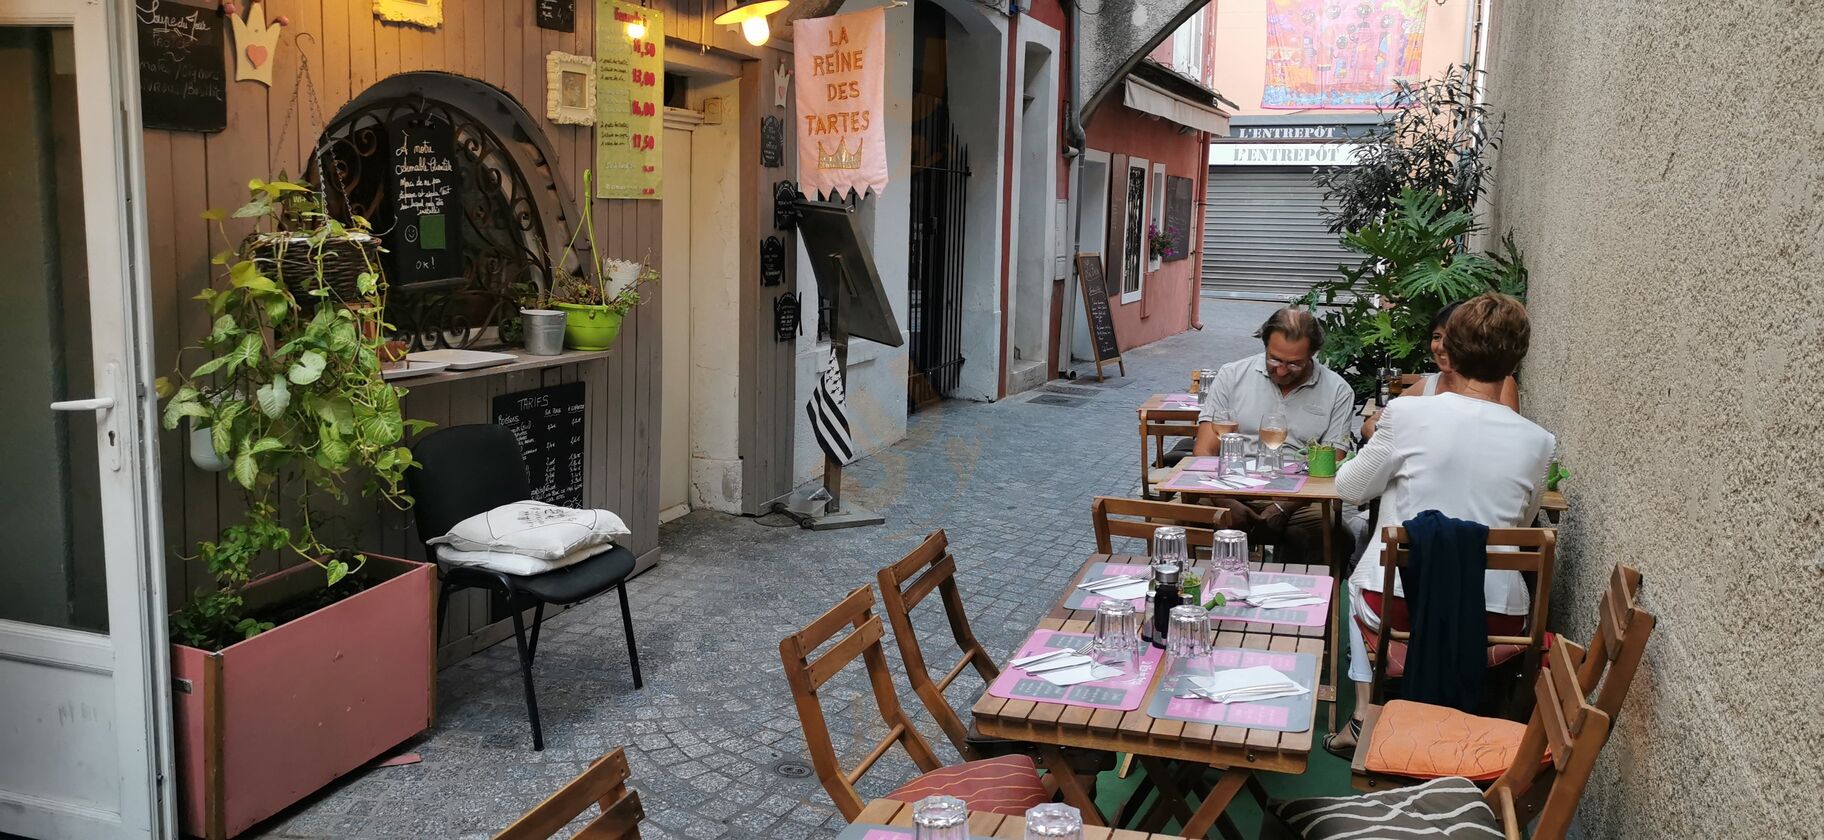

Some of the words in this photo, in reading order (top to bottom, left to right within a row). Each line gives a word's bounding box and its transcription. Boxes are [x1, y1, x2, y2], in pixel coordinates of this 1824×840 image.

[829, 27, 849, 47] LA
[826, 81, 860, 102] DES
[805, 111, 870, 136] TARTES
[1239, 125, 1336, 139] L'ENTREPÔT
[1233, 144, 1340, 162] L'ENTREPÔT
[517, 395, 549, 411] TARIFS
